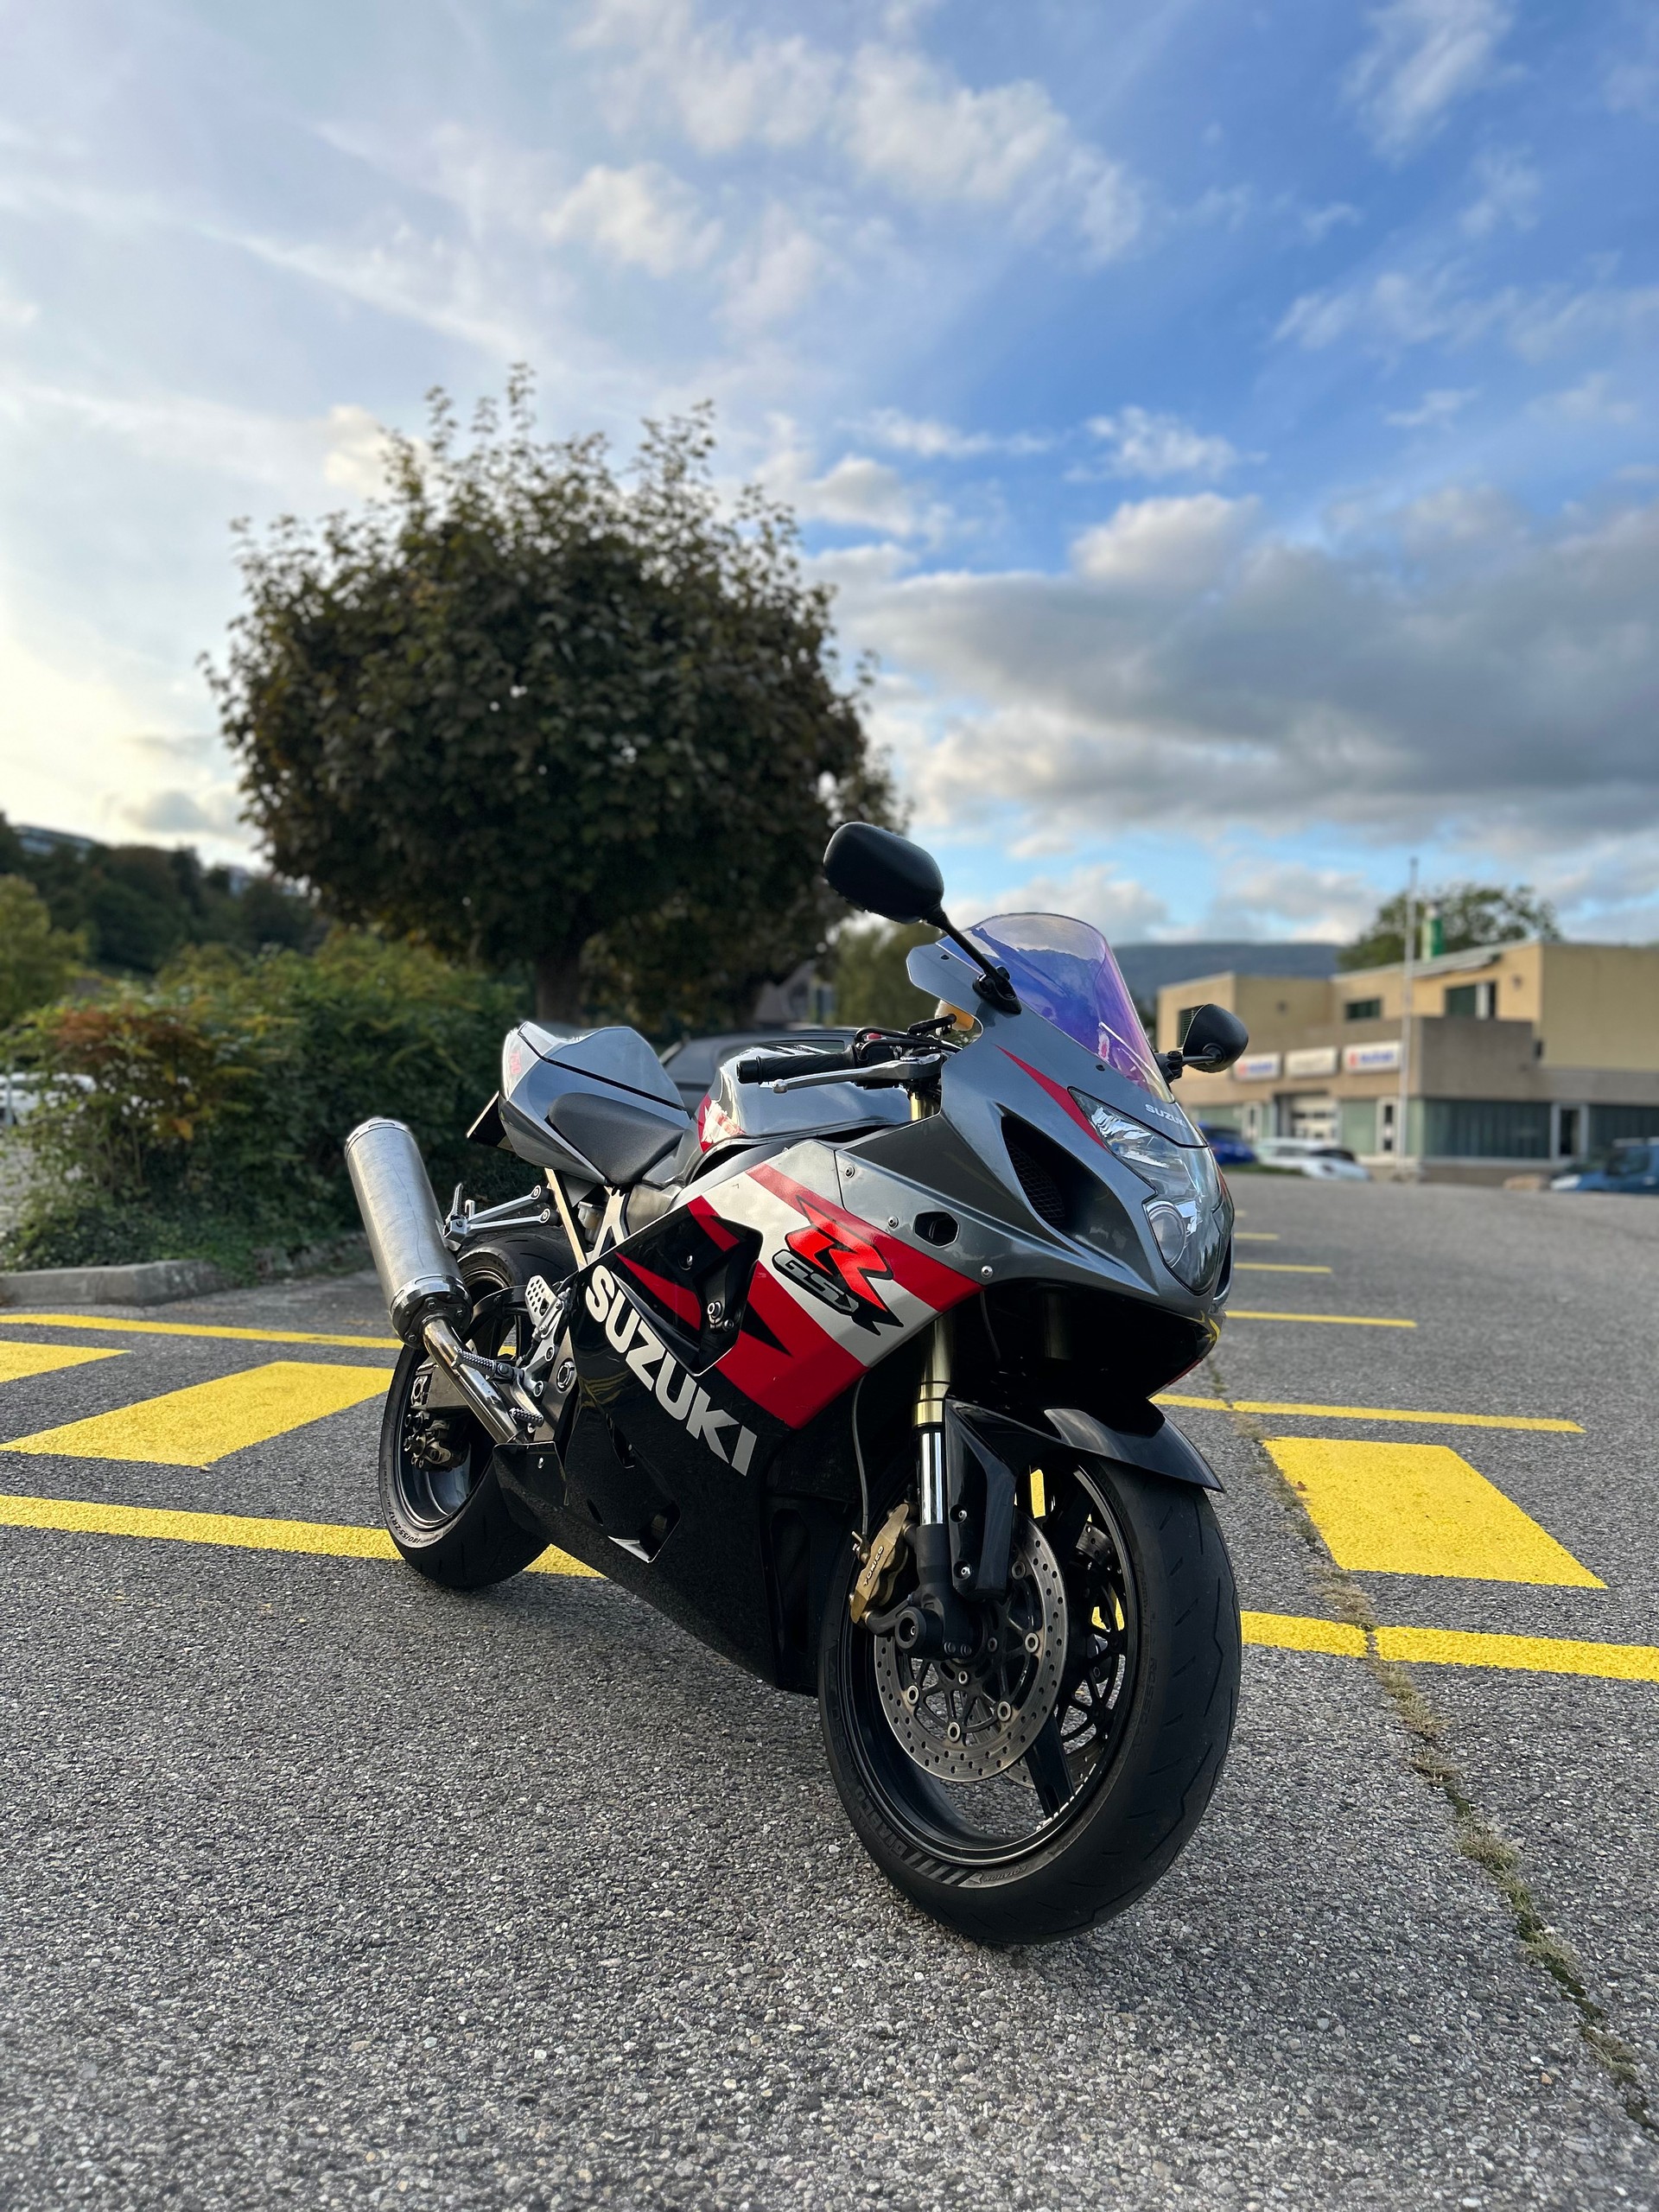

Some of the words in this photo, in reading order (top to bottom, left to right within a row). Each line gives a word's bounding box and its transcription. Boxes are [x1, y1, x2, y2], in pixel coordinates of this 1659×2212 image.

[585, 1265, 758, 1477] SUZUKI
[862, 1545, 884, 1587] TOKICO
[855, 1785, 909, 1859] DIABLO
[983, 1866, 1027, 1882] ROTATION
